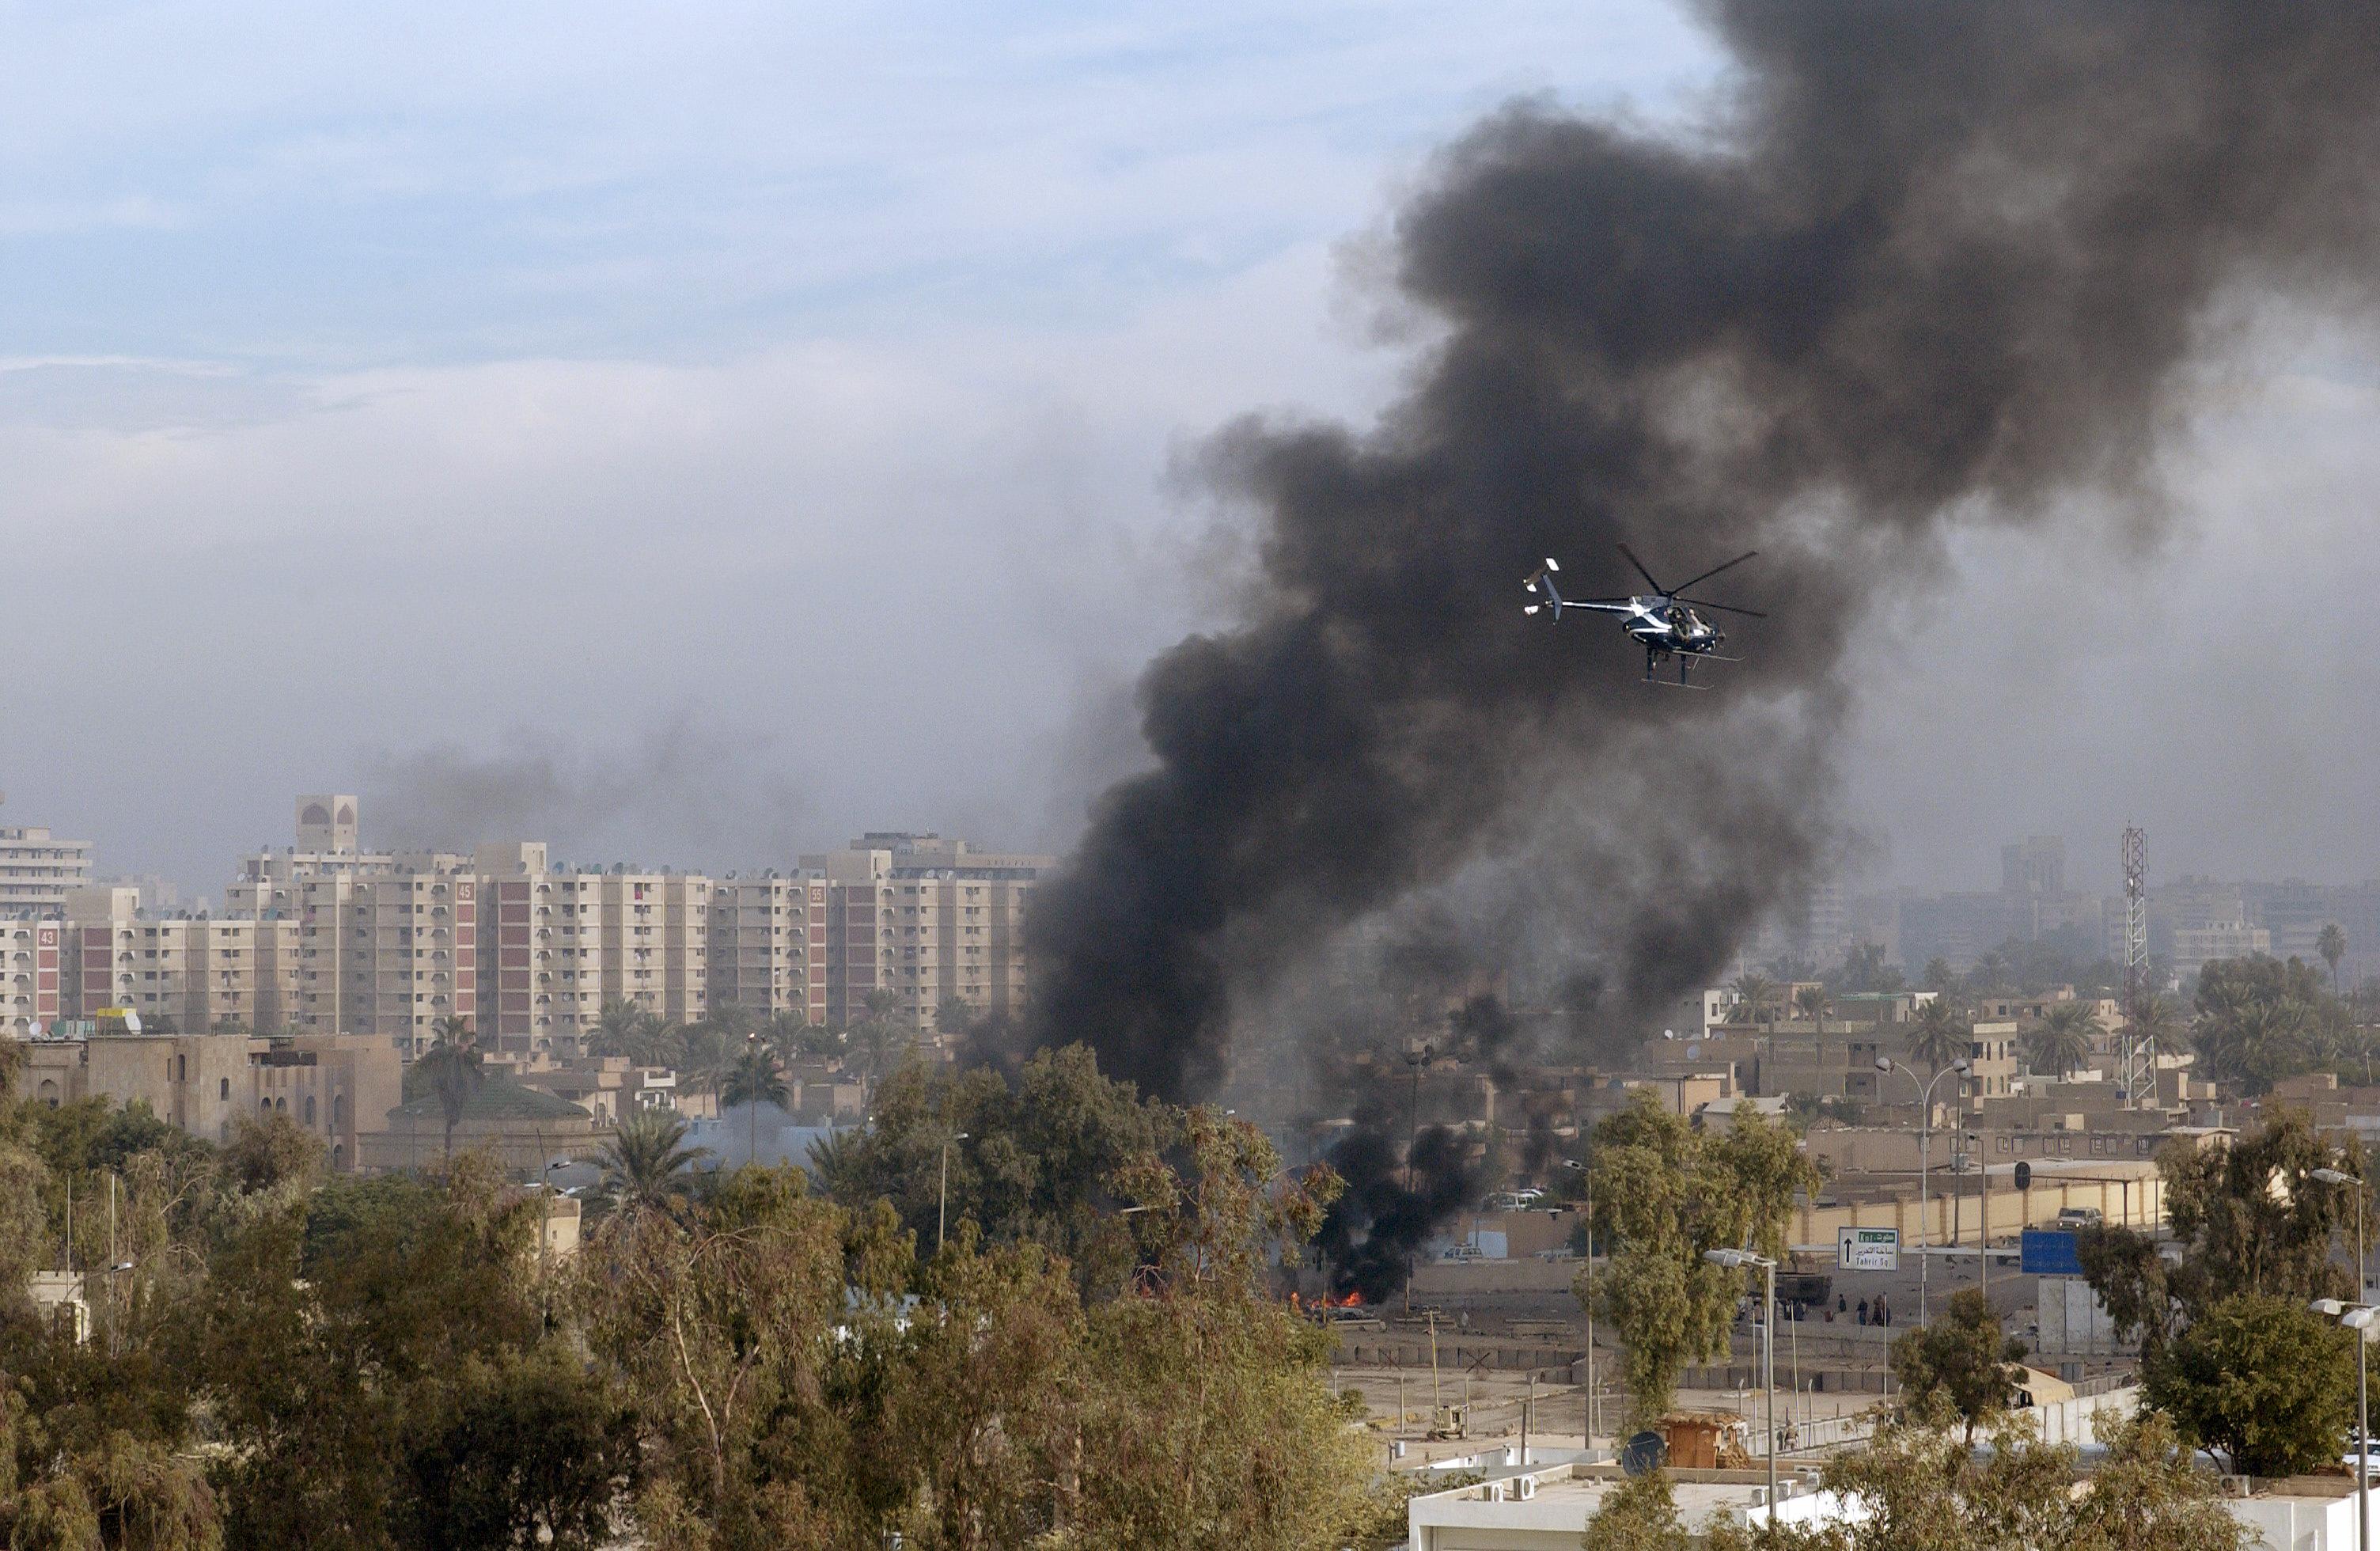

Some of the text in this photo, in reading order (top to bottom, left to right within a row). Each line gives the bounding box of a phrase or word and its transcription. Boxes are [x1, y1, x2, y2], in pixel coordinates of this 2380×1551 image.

[459, 885, 471, 898] 45
[40, 931, 54, 944] 43
[1856, 1257, 1878, 1266] Tahrir
